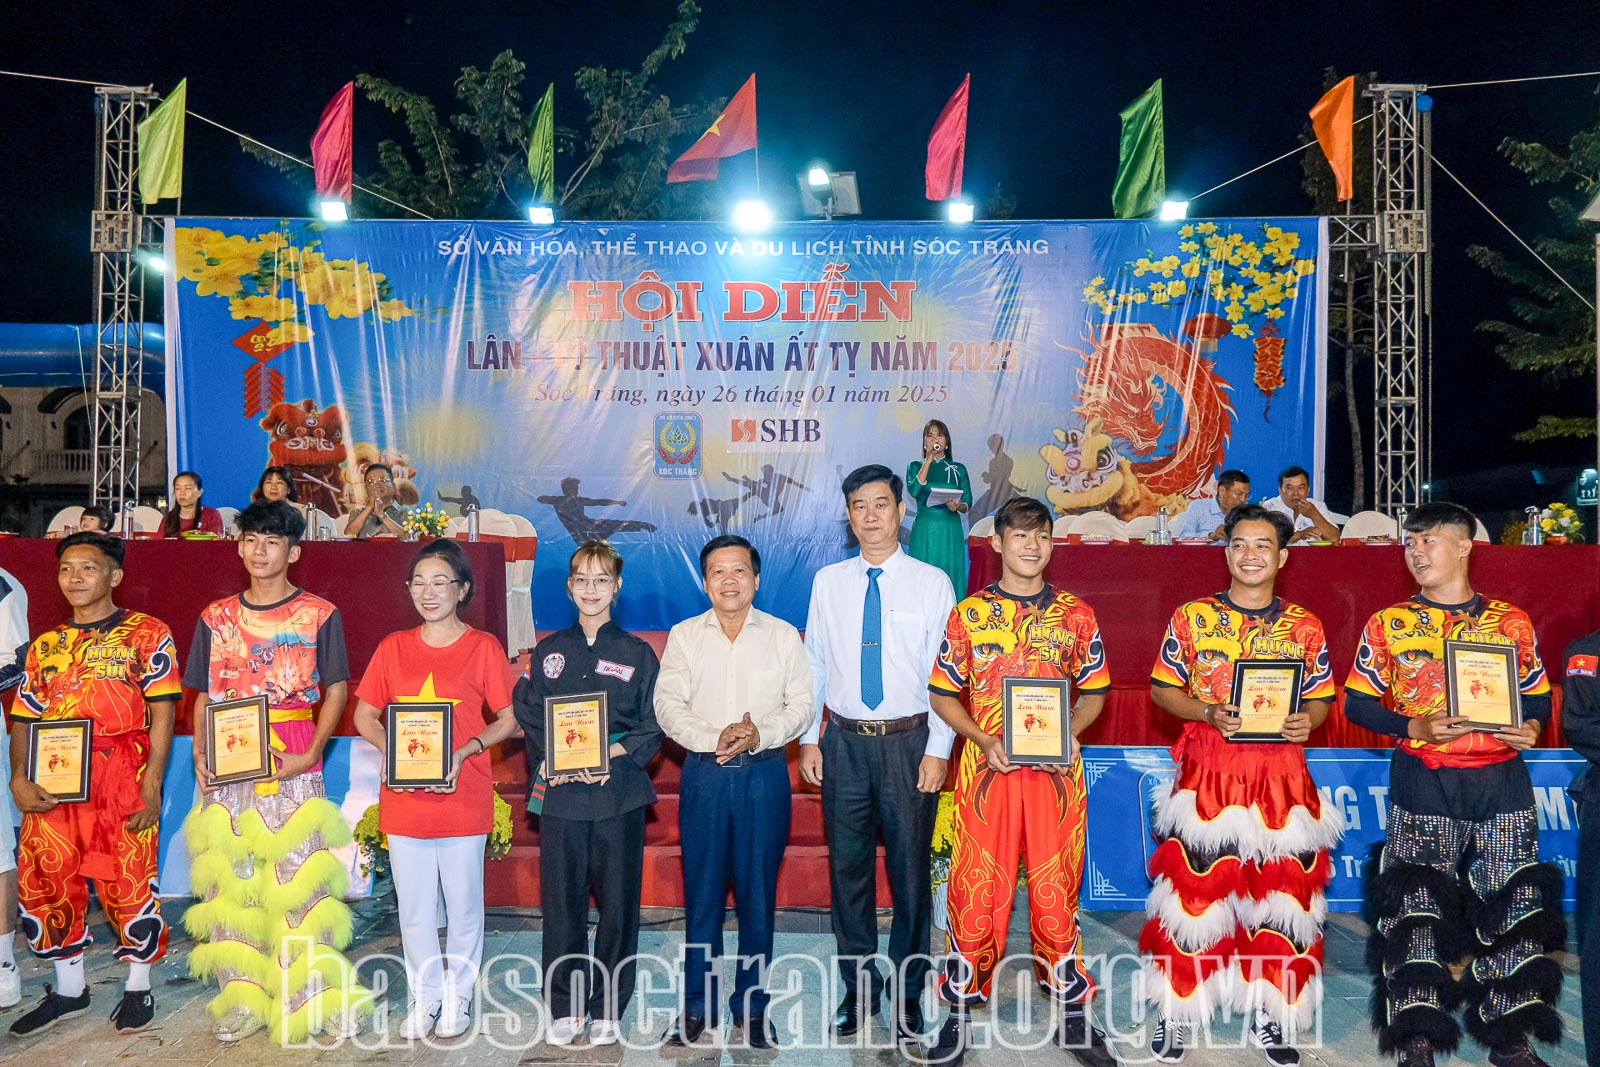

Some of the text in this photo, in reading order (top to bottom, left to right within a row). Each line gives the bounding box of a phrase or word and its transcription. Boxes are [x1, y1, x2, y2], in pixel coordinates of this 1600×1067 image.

[438, 233, 1049, 259] SỞ VĂN HÓA, THỂ THAO VÀ DU LỊCH TỈNH SÓC TRĂNG
[567, 262, 917, 332] HỘI DIỄN
[466, 334, 522, 370] LÂN
[597, 335, 687, 378] THUẬT
[695, 335, 775, 372] XUÂN
[784, 331, 819, 372] ẤT
[829, 341, 861, 378] TỴ
[870, 334, 938, 371] NĂM
[946, 340, 1019, 372] 2025
[655, 386, 706, 406] ngày
[712, 385, 738, 403] 26
[744, 385, 804, 407] tháng
[811, 385, 835, 402] 01
[844, 387, 890, 403] năm
[897, 385, 948, 403] 2025
[761, 419, 821, 443] SHB
